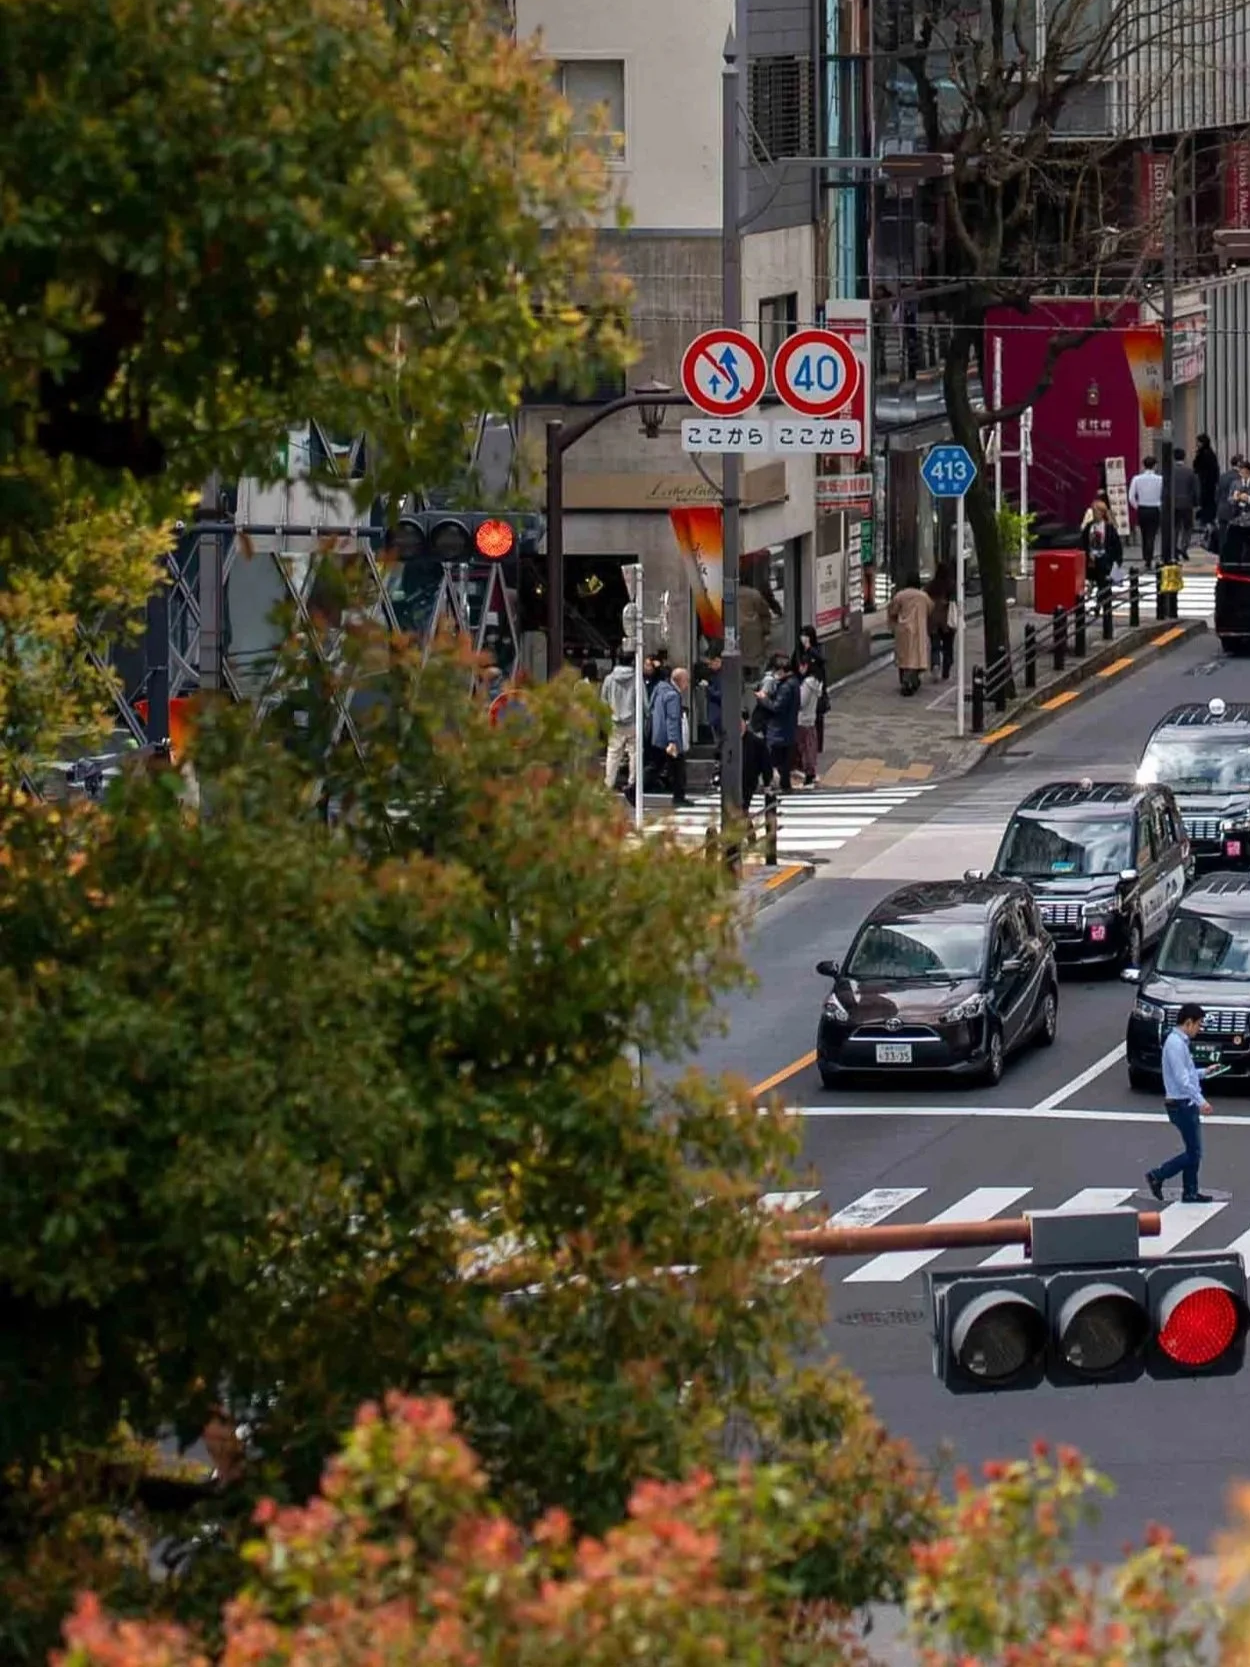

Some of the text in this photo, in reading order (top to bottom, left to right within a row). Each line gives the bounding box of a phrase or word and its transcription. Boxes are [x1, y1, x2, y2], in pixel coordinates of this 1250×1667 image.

[793, 354, 839, 392] 40
[687, 427, 764, 446] ここから
[779, 428, 855, 446] ここから
[930, 461, 967, 481] 413
